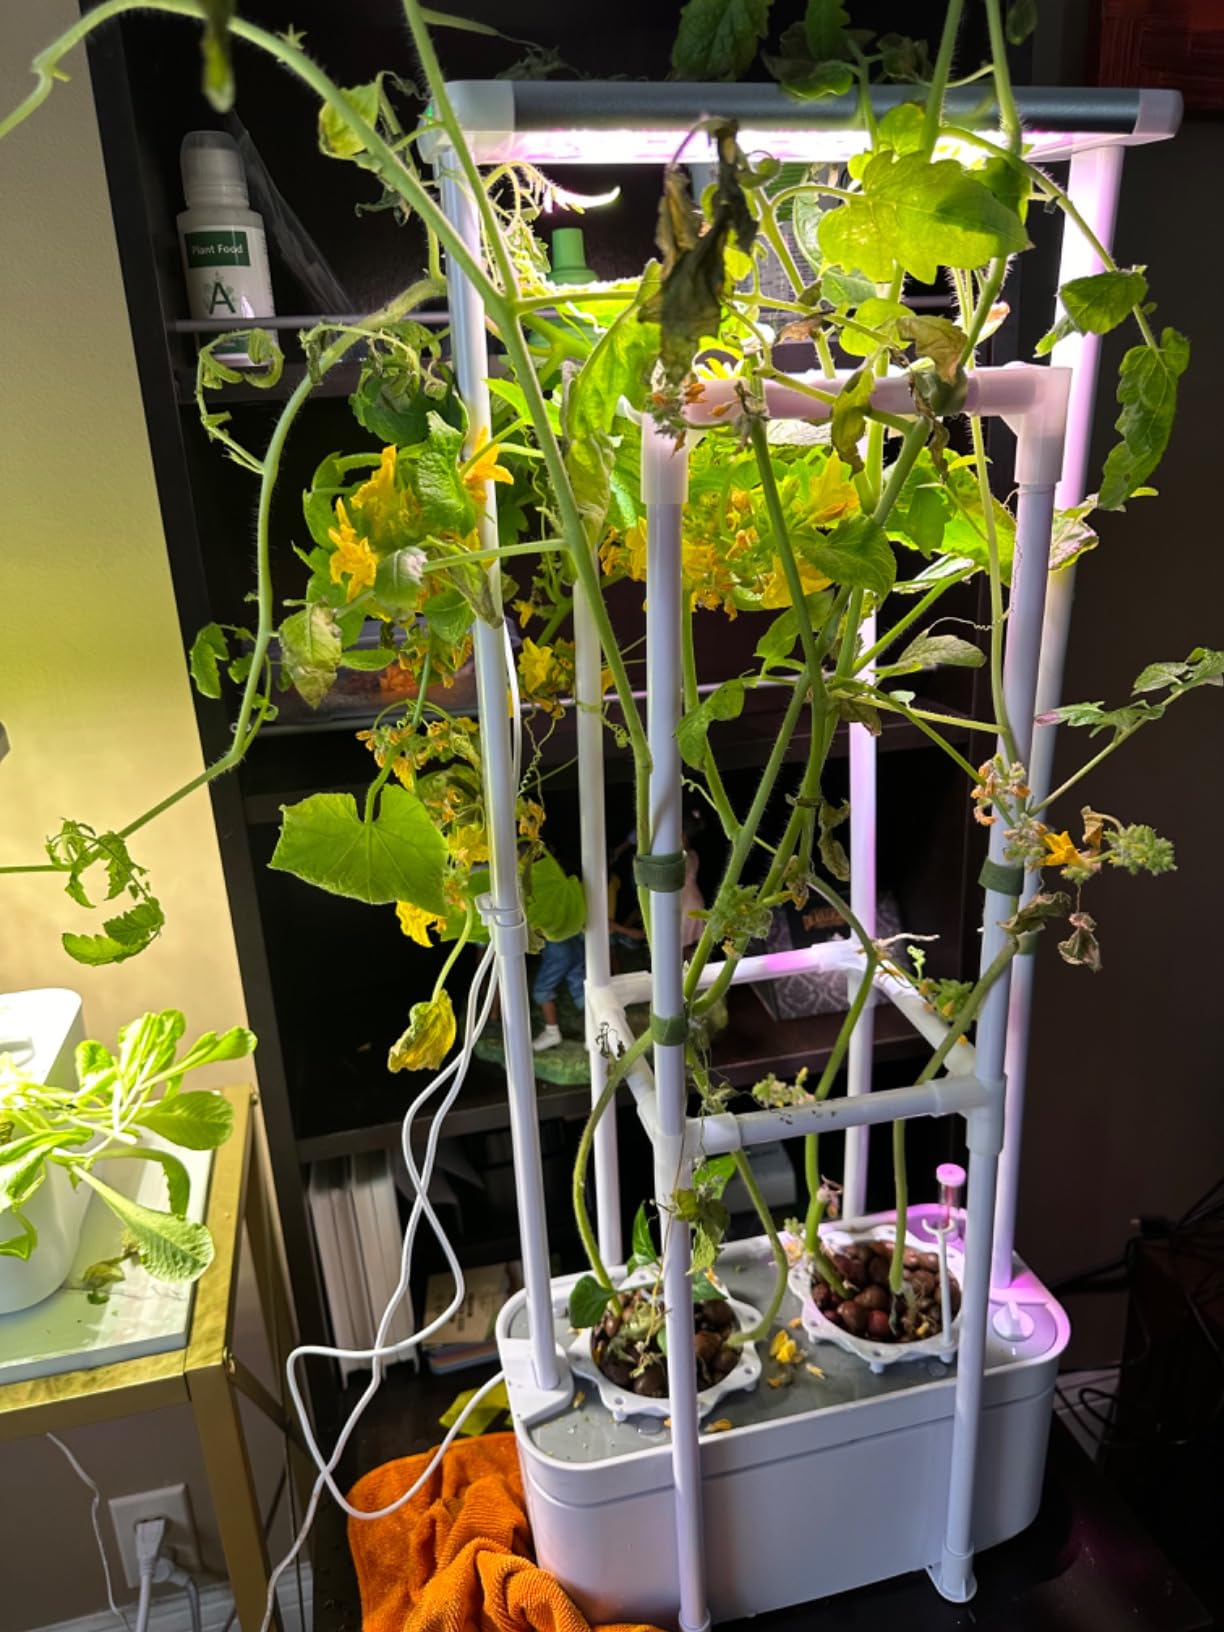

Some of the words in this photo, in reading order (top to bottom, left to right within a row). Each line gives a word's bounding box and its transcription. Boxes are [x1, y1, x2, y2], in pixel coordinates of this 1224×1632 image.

[192, 245, 215, 255] Plant
[217, 243, 243, 254] Food
[209, 282, 236, 314] A
